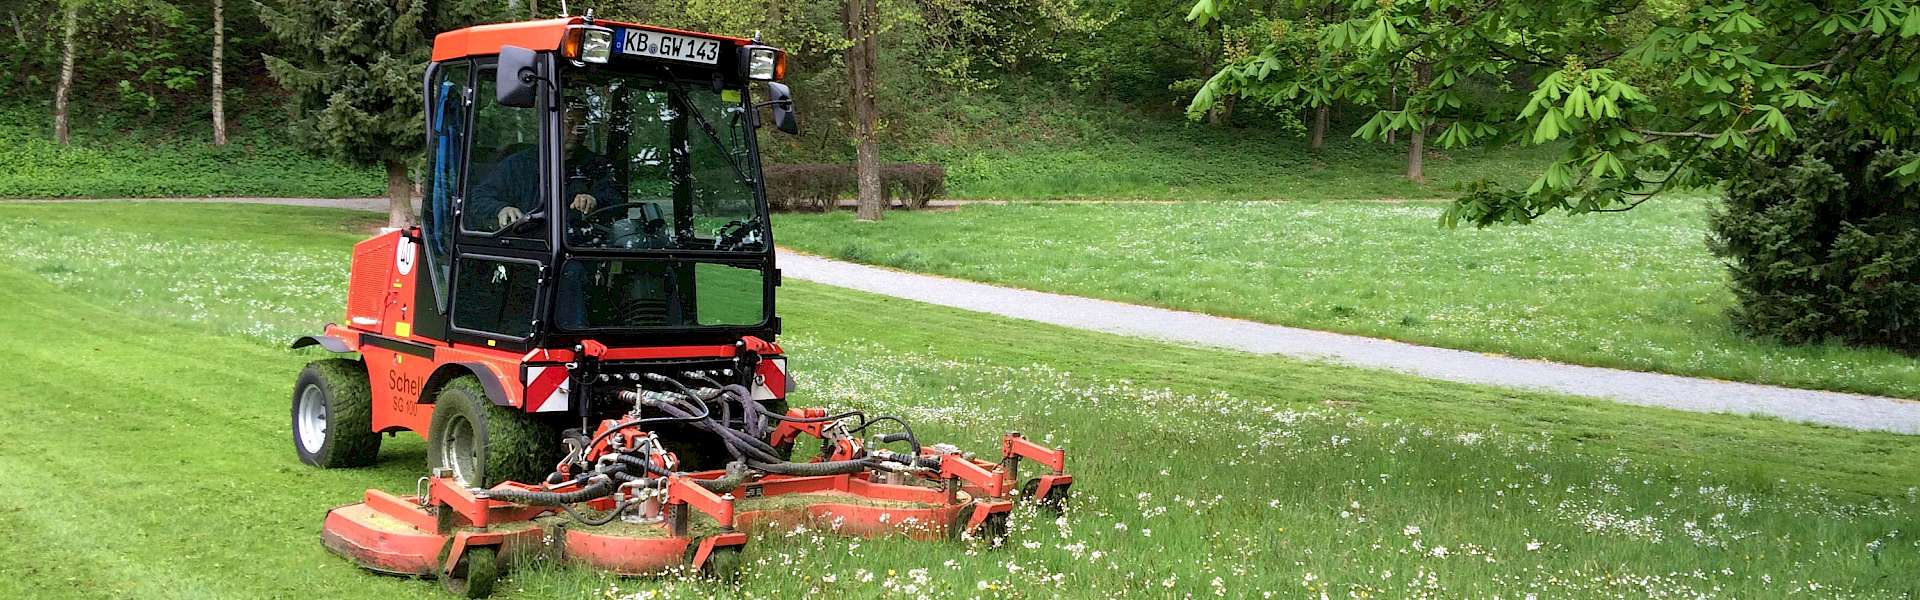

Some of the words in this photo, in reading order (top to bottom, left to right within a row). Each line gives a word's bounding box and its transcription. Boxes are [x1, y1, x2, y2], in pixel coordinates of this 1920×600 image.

[625, 31, 649, 52] KB
[660, 36, 684, 56] GW
[686, 40, 718, 61] 143
[393, 395, 404, 413] SG
